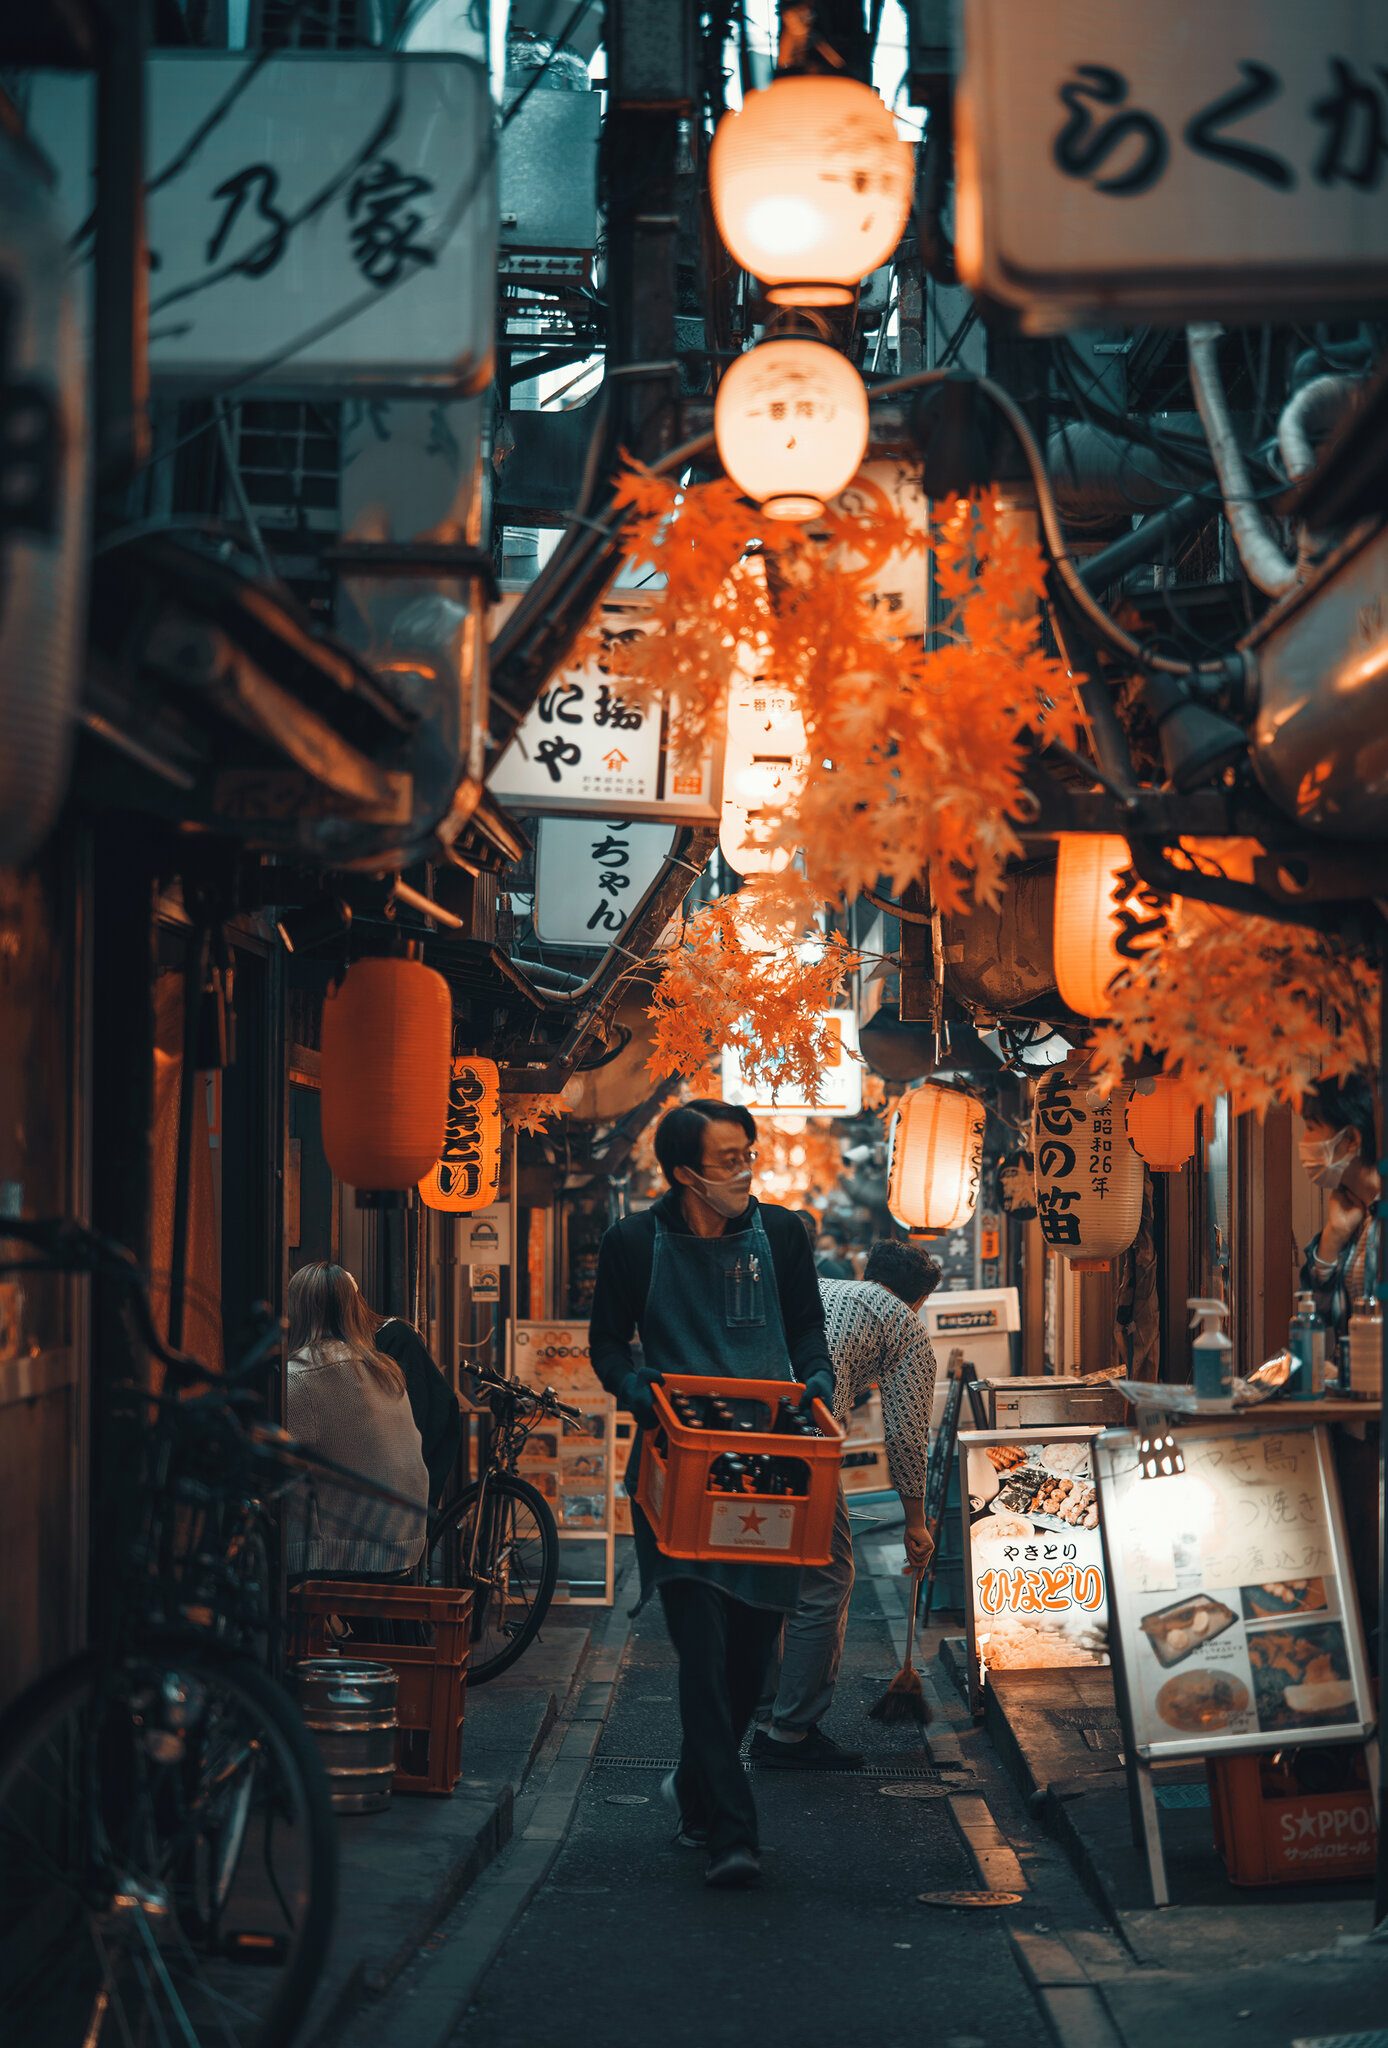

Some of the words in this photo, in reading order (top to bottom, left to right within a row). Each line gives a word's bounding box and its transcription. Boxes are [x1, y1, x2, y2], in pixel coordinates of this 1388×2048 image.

[147, 158, 437, 288] 乃家
[1035, 1072, 1088, 1246] 志の笛
[977, 1563, 1104, 1615] ひなどり
[1003, 1543, 1078, 1562] やきとり
